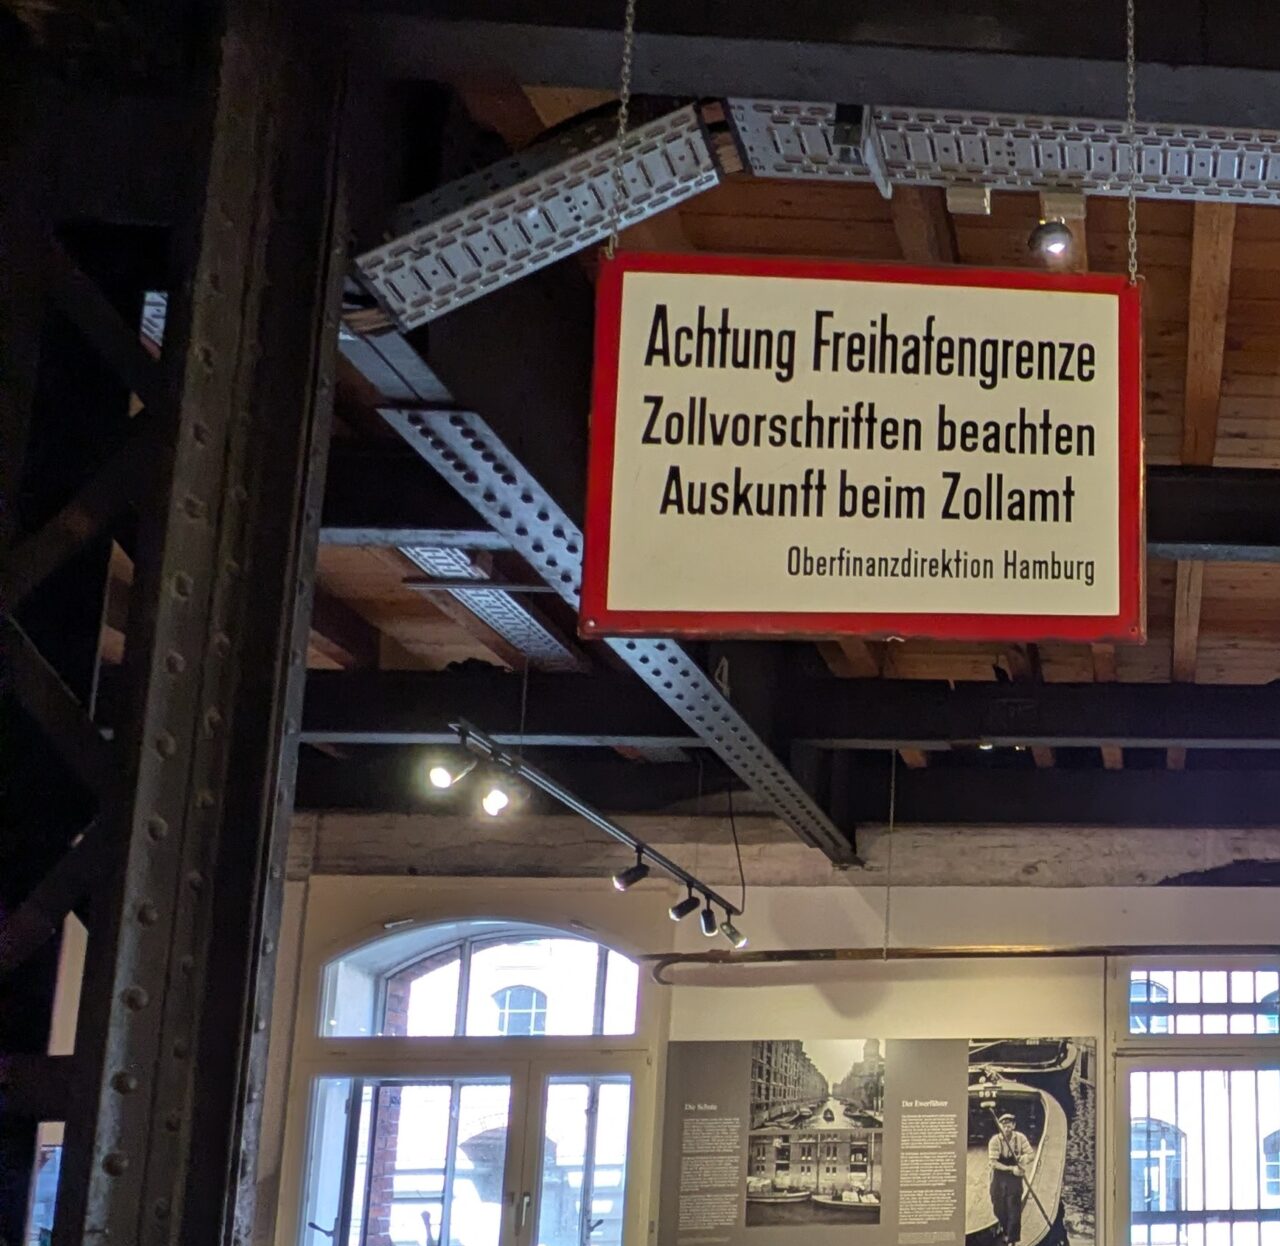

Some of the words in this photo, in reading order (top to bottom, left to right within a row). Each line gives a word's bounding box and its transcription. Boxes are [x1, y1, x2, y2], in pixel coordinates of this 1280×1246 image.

[643, 303, 796, 384] Achtung
[812, 309, 1096, 390] Freihafengrenze
[641, 395, 922, 452] Zollvorschriften
[937, 404, 1096, 458] beachten
[660, 465, 827, 518] Auskunft
[839, 472, 925, 520] beim
[940, 471, 1076, 523] Zollamt
[786, 546, 995, 581] Oberfinanzdirektion
[1003, 550, 1096, 587] Hamburg
